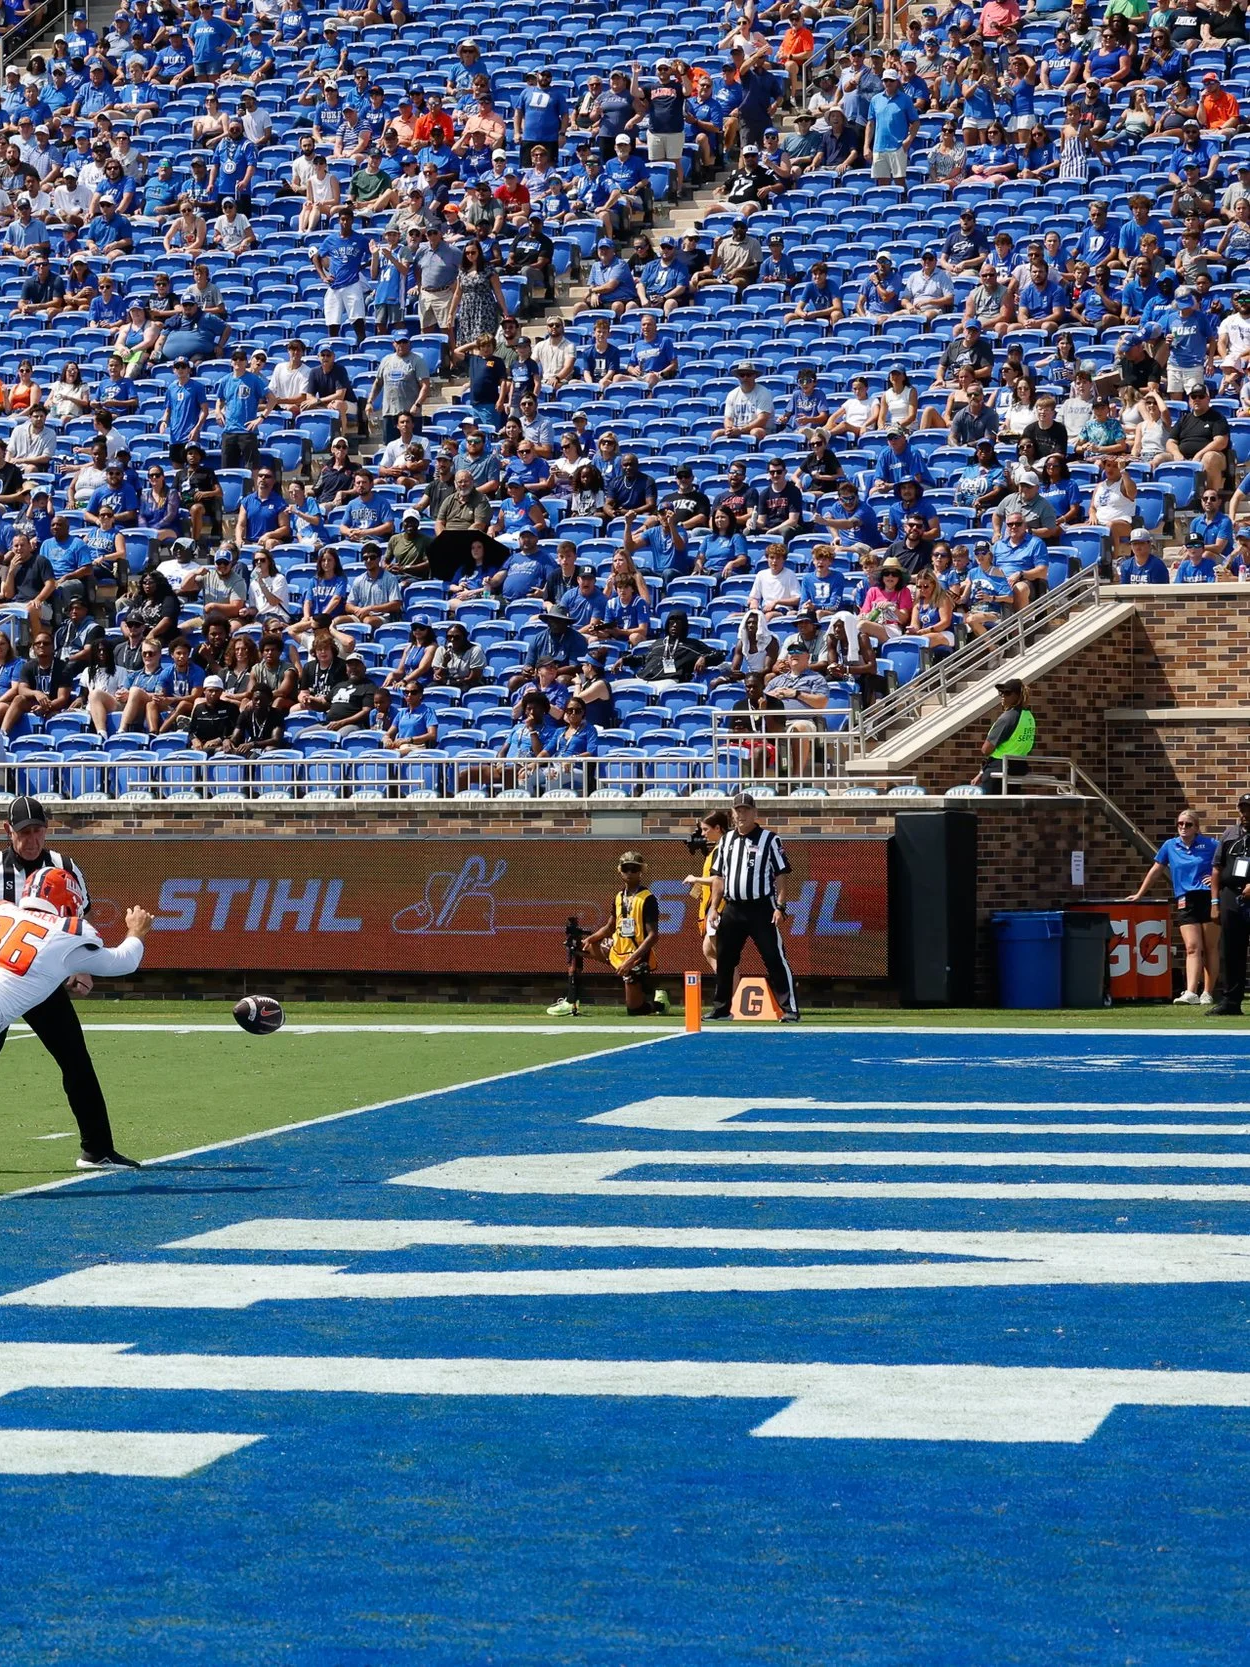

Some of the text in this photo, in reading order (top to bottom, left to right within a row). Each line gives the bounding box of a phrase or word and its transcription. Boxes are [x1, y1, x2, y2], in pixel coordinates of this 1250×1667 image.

[1175, 17, 1197, 25] DUKE
[163, 55, 186, 63] DUKE
[1049, 60, 1071, 68] DUKE
[6, 880, 13, 890] S
[152, 878, 363, 932] STIHL
[1135, 919, 1169, 977] G
[739, 985, 764, 1017] G
